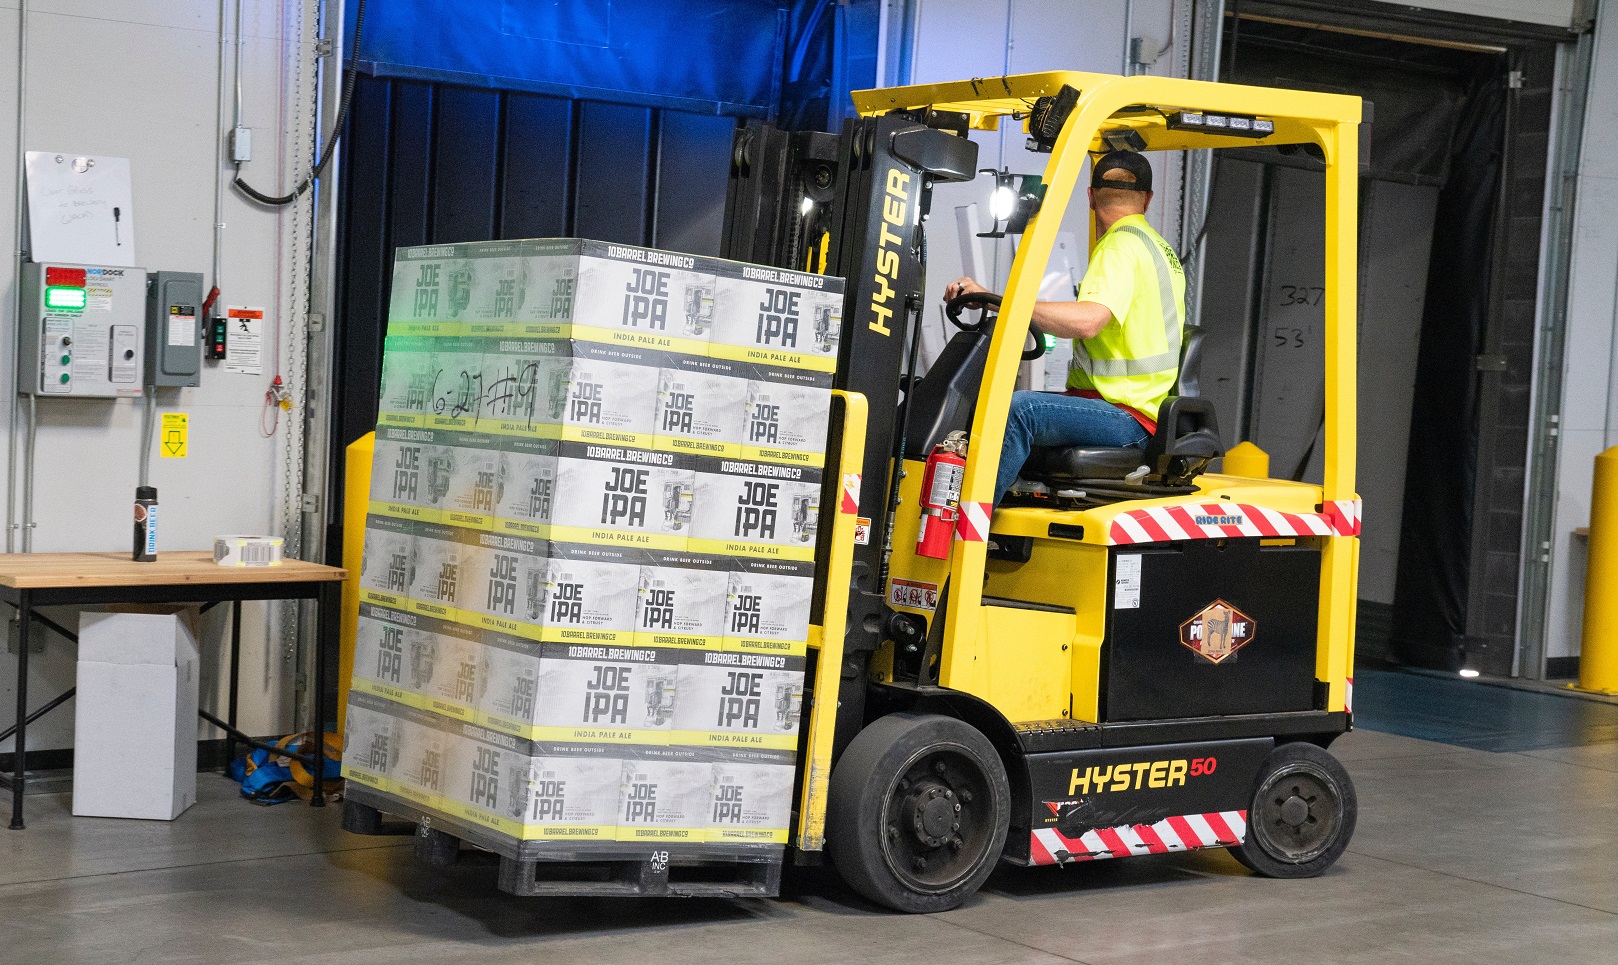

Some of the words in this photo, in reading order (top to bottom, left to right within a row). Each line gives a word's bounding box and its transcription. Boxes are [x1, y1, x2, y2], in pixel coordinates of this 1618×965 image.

[868, 168, 910, 337] HYSTER
[416, 263, 441, 288] JOE
[552, 278, 574, 296] JOE
[626, 268, 671, 298] JOE
[495, 279, 516, 297] JOE
[1280, 285, 1325, 308] 327
[413, 288, 439, 318] IPA
[493, 297, 514, 318] IPA
[549, 297, 572, 319] IPA
[622, 294, 668, 331] IPA
[760, 288, 801, 316] JOE
[613, 333, 635, 342] INDIA
[638, 335, 655, 345] PALE
[658, 338, 671, 347] ALE
[756, 313, 799, 348] IPA
[747, 350, 768, 360] INDIA
[770, 353, 787, 362] PALE
[788, 356, 801, 364] ALE
[572, 381, 603, 402] JOE
[665, 392, 695, 412] JOE
[570, 399, 602, 424] IPA
[663, 409, 693, 434] IPA
[752, 403, 780, 423] JOE
[749, 421, 778, 444] IPA
[396, 446, 421, 470] JOE
[393, 470, 419, 500] IPA
[475, 471, 494, 489] JOE
[531, 478, 552, 496] JOE
[604, 466, 650, 495] JOE
[473, 489, 493, 511] IPA
[738, 481, 780, 508] JOE
[529, 496, 551, 519] IPA
[600, 493, 648, 528] IPA
[734, 506, 777, 539] IPA
[1196, 516, 1219, 525] RIDE
[1220, 515, 1243, 524] RITE
[148, 530, 156, 553] DRINK
[592, 532, 614, 540] INDIA
[616, 534, 634, 542] PALE
[636, 535, 650, 543] ALE
[726, 544, 746, 552] INDIA
[767, 547, 780, 555] ALE
[390, 554, 407, 572] JOE
[439, 562, 458, 581] JOE
[490, 554, 519, 582] JOE
[388, 569, 406, 592] IPA
[437, 579, 456, 602] IPA
[553, 582, 584, 601] JOE
[487, 579, 517, 615] IPA
[645, 589, 675, 607] JOE
[733, 594, 762, 612] JOE
[550, 600, 582, 624] IPA
[643, 606, 674, 629] IPA
[731, 611, 761, 634] IPA
[380, 626, 403, 653] JOE
[377, 649, 402, 684] IPA
[458, 662, 476, 681] JOE
[513, 676, 534, 697] JOE
[587, 665, 632, 692] JOE
[721, 671, 764, 697] JOE
[455, 679, 475, 704] IPA
[511, 694, 532, 720] IPA
[582, 691, 630, 724] IPA
[717, 696, 761, 729] IPA
[574, 730, 596, 738] INDIA
[599, 731, 616, 739] PALE
[618, 732, 632, 740] ALE
[732, 735, 748, 743] PALE
[750, 736, 763, 744] ALE
[473, 746, 501, 777] JOE
[1068, 759, 1188, 796] HYSTER
[1189, 756, 1217, 777] 50
[470, 771, 499, 809] IPA
[535, 781, 566, 798] JOE
[628, 783, 658, 801] JOE
[715, 784, 744, 802] JOE
[533, 798, 565, 821] IPA
[625, 800, 656, 822] IPA
[712, 802, 742, 824] IPA
[651, 862, 666, 870] INC
